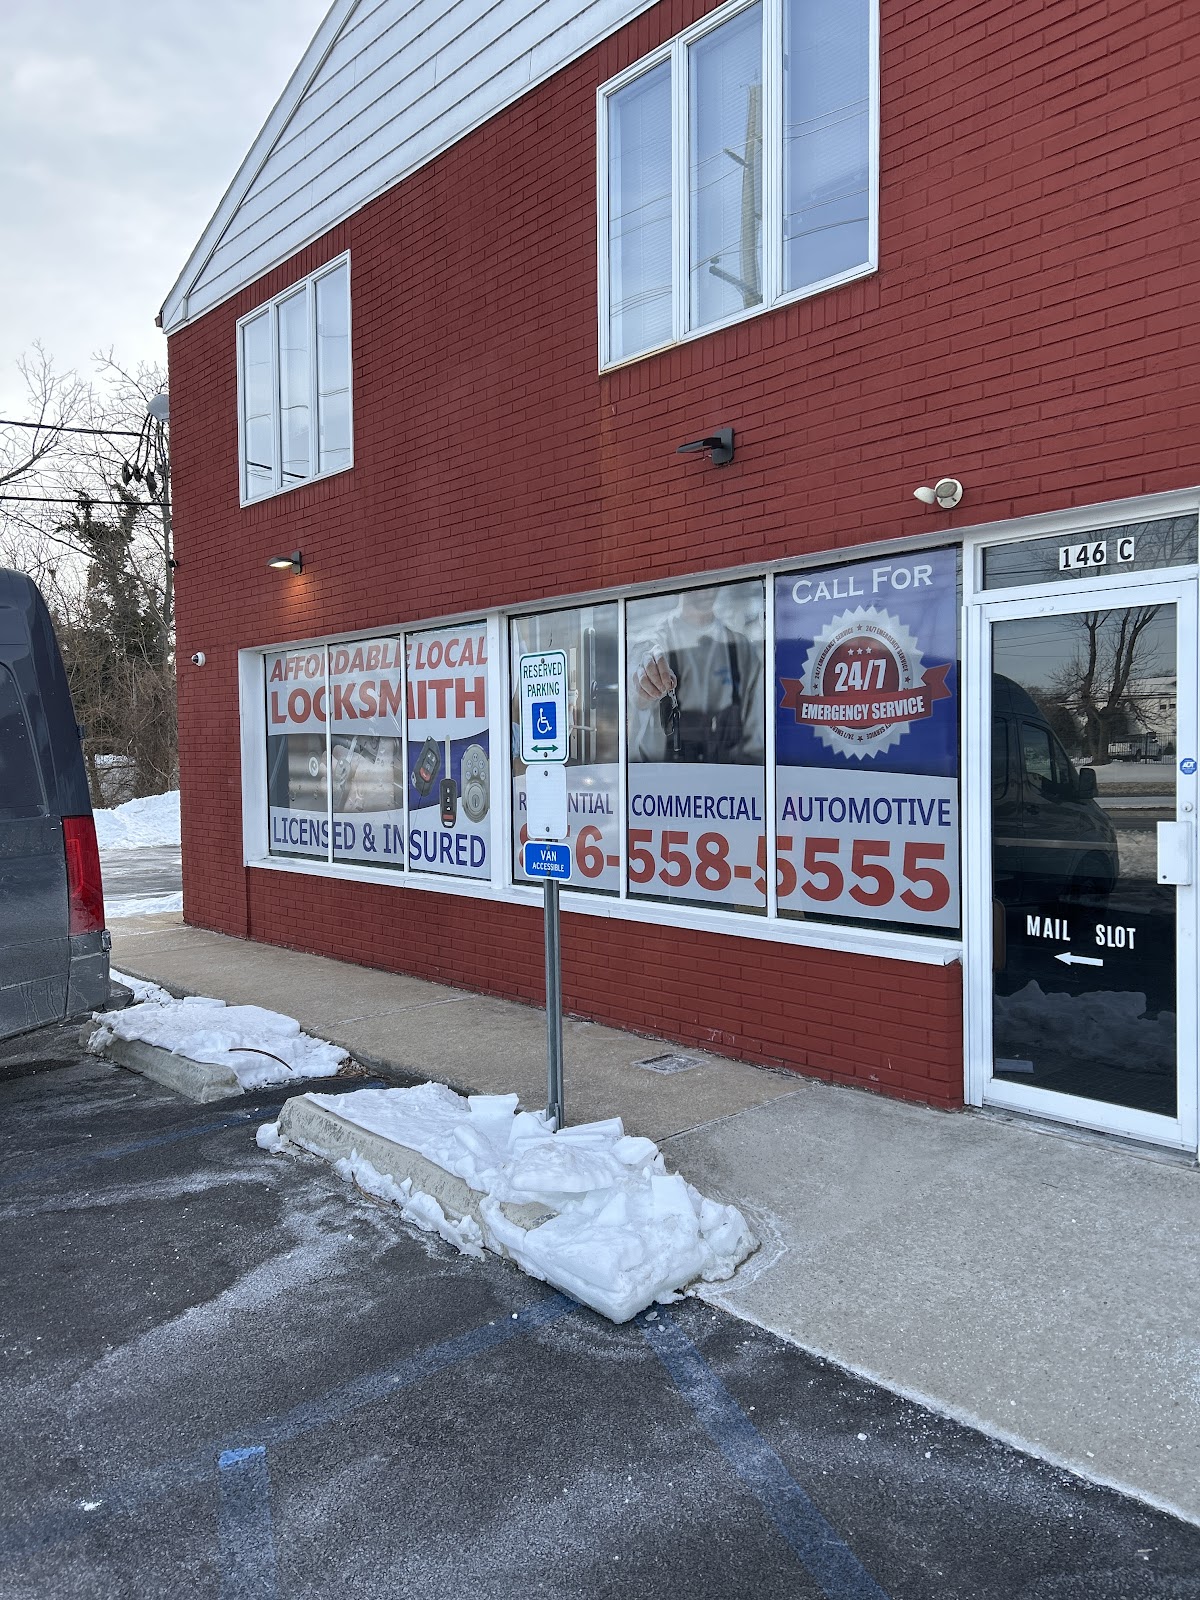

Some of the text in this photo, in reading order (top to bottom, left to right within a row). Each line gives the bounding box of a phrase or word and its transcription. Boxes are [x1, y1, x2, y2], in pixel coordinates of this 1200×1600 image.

[1063, 539, 1133, 568] 146 C
[792, 564, 933, 604] CALL FOR
[835, 626, 854, 642] SERVICE
[865, 625, 909, 673] 24/7 EMERGENCY SERVICE
[270, 636, 488, 682] AFFORDABLE LOCAL
[523, 661, 563, 679] RESERVED
[834, 658, 887, 692] 24/7
[271, 676, 486, 724] LOCKSMITH
[527, 681, 560, 698] PARKING
[801, 695, 925, 721] EMERGENCY SERVICE
[518, 791, 952, 826] RNTIAL COMMERCIAL AUTOMOTIVE
[273, 816, 486, 868] LICENSED & INSURED
[540, 849, 557, 862] VAN
[518, 822, 951, 912] 6-558-5555
[532, 861, 565, 873] ACCESSIBLE
[1026, 914, 1136, 950] MAIL SLOT
